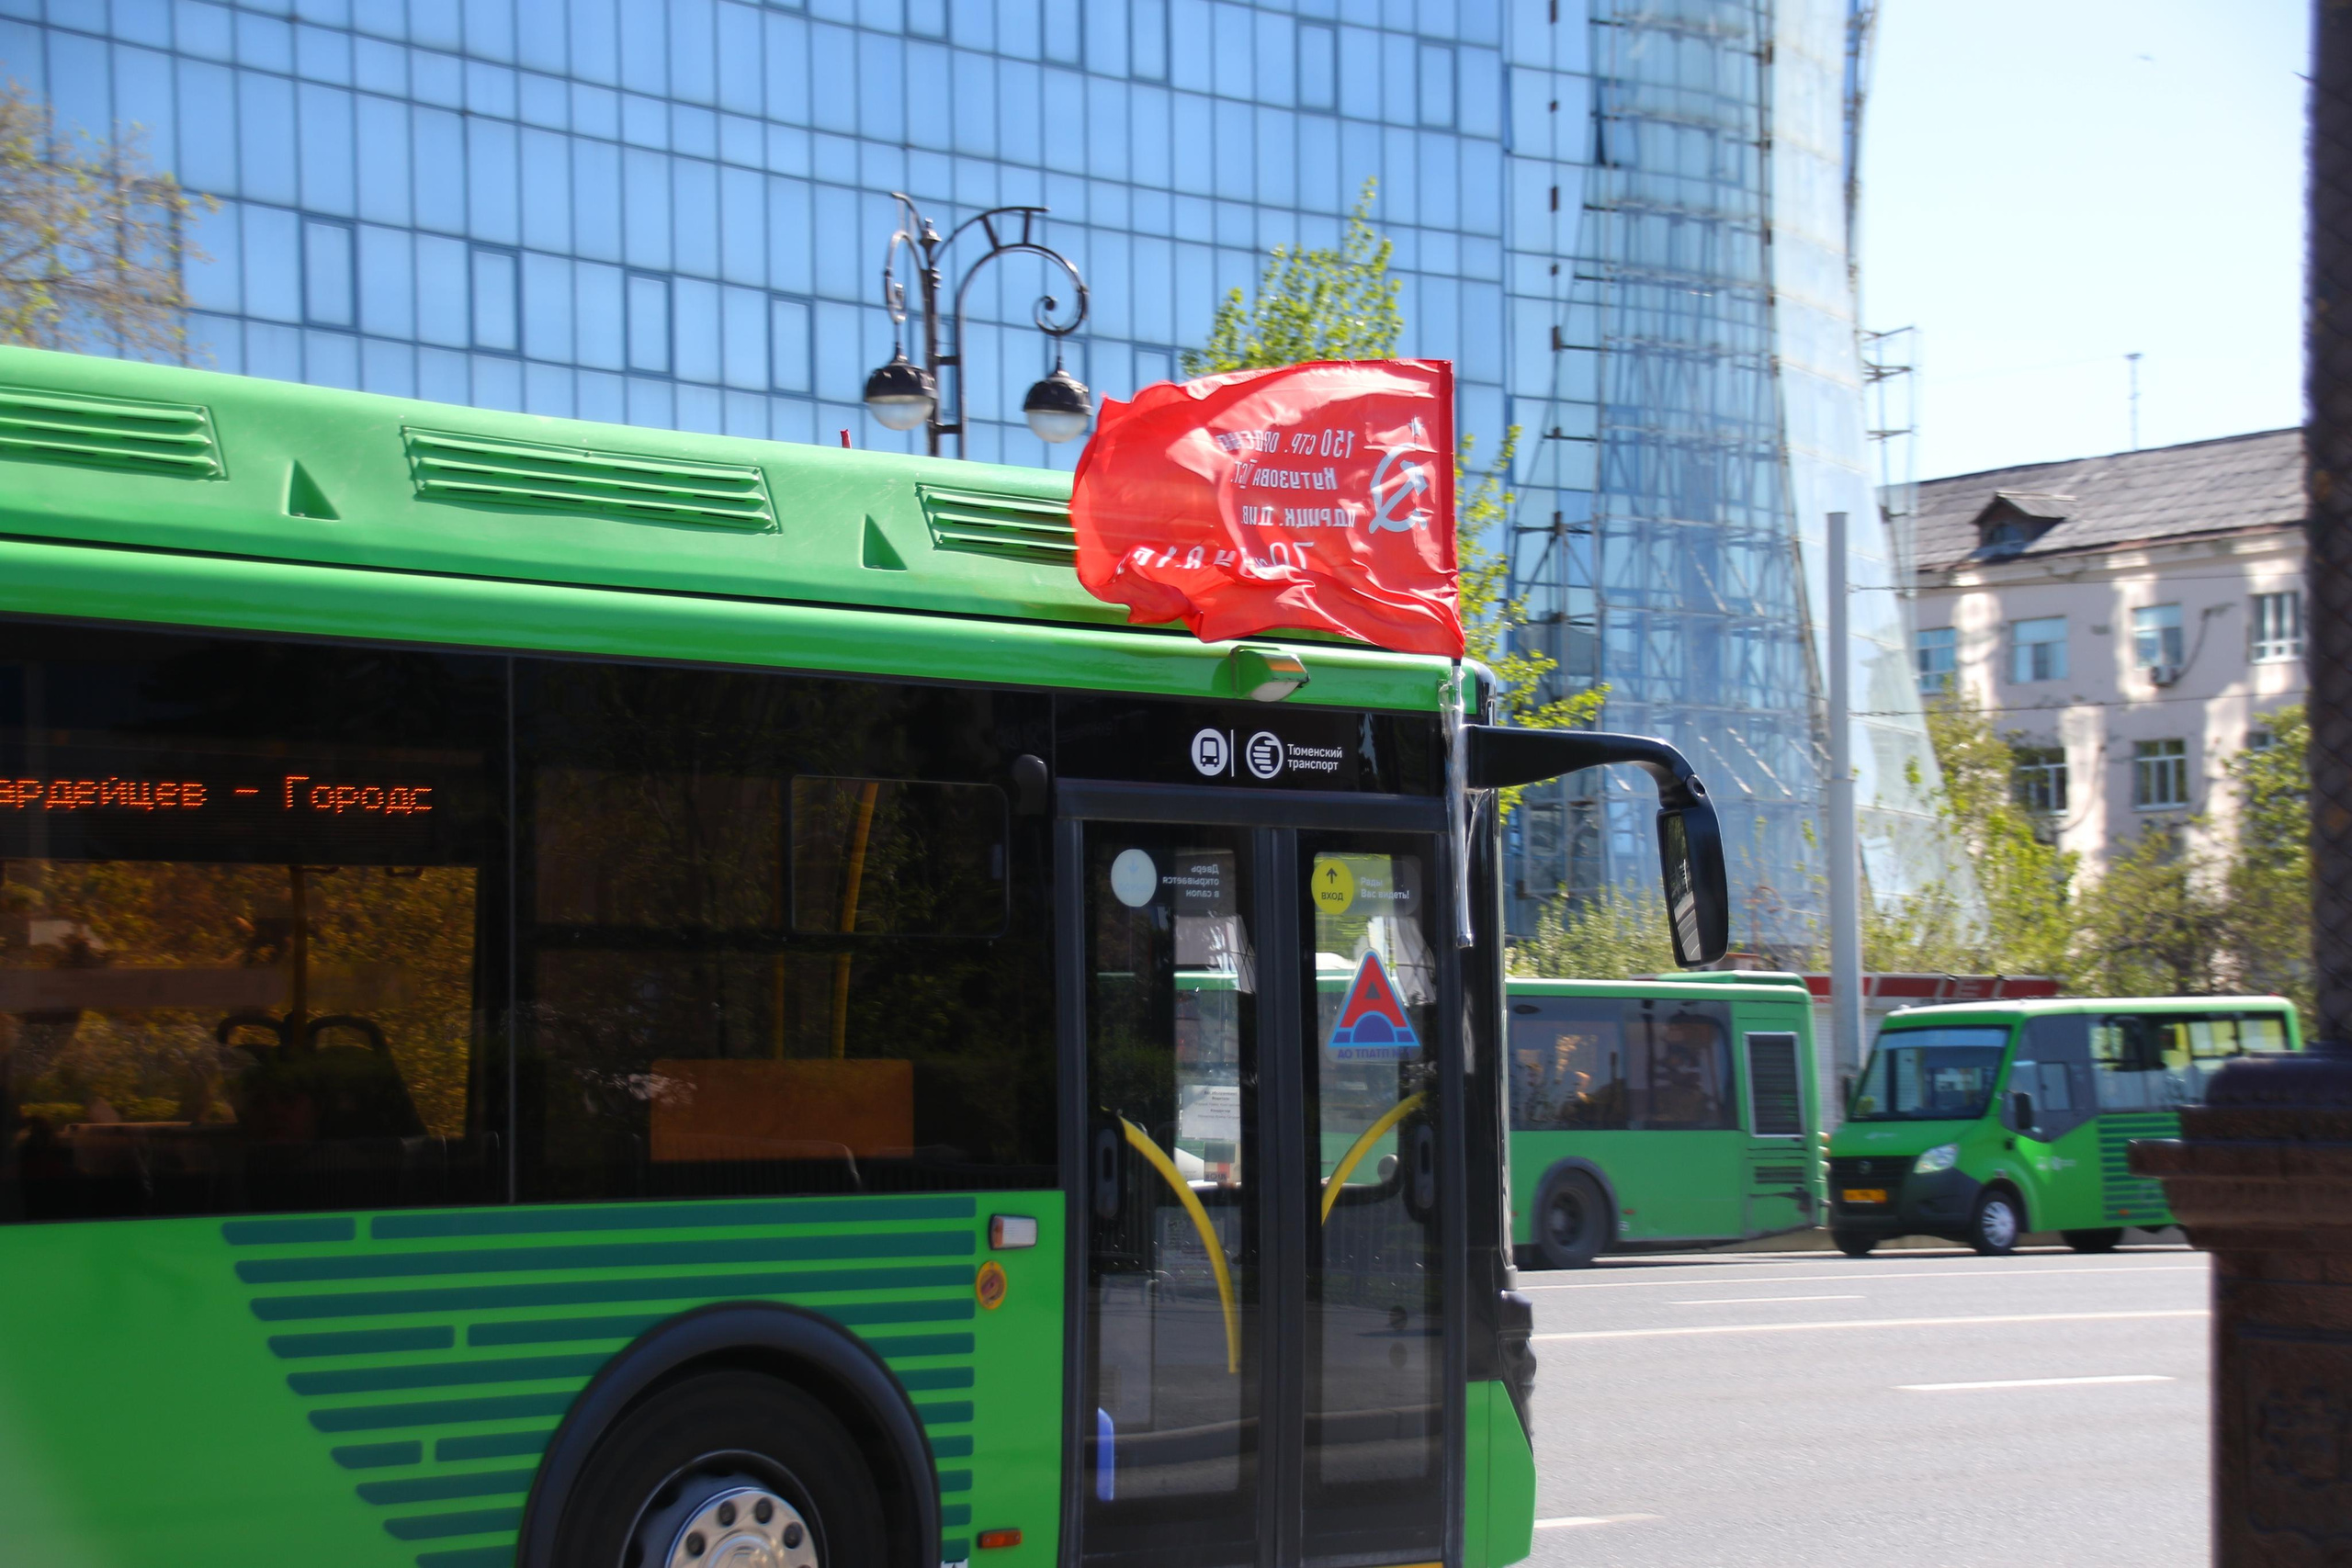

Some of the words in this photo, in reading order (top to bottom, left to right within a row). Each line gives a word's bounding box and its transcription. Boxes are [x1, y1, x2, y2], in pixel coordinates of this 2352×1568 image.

[1287, 743, 1342, 759] Тюменский
[1287, 759, 1339, 773] транспорт
[1361, 876, 1383, 886] Рады
[1321, 892, 1343, 901] ВХОД
[1361, 889, 1376, 898] Вас
